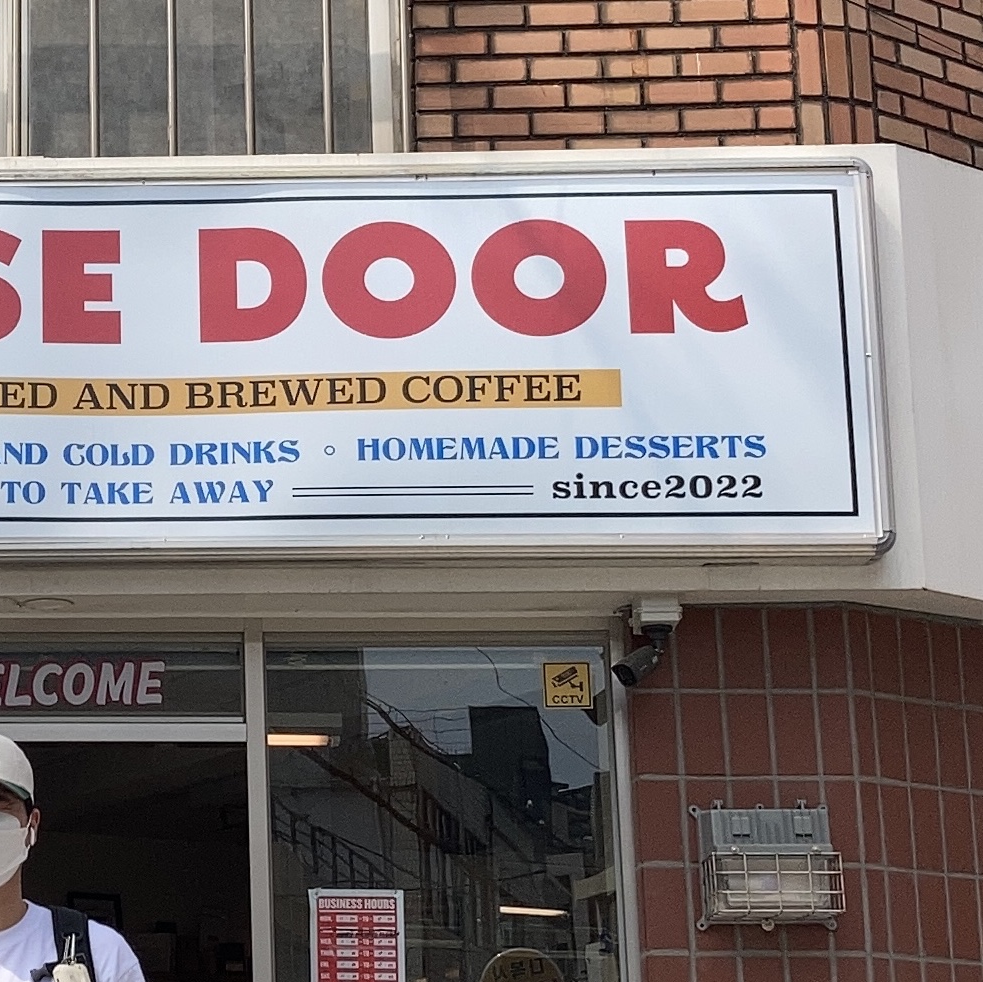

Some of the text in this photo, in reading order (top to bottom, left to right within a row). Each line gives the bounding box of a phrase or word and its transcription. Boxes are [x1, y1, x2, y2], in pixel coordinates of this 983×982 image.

[198, 219, 748, 343] DOOR
[73, 380, 170, 411] AND
[185, 376, 387, 408] BREWED
[401, 373, 582, 404] COFFEE
[63, 440, 155, 467] COLD
[169, 439, 300, 466] DRINKS
[357, 436, 559, 462] HOMEMADE
[574, 434, 767, 460] DESSERTS
[1, 479, 274, 504] TO TAKE AWAY
[552, 472, 764, 500] since2022
[552, 694, 583, 704] CCTV
[318, 898, 395, 909] BUSINESS HOURS
